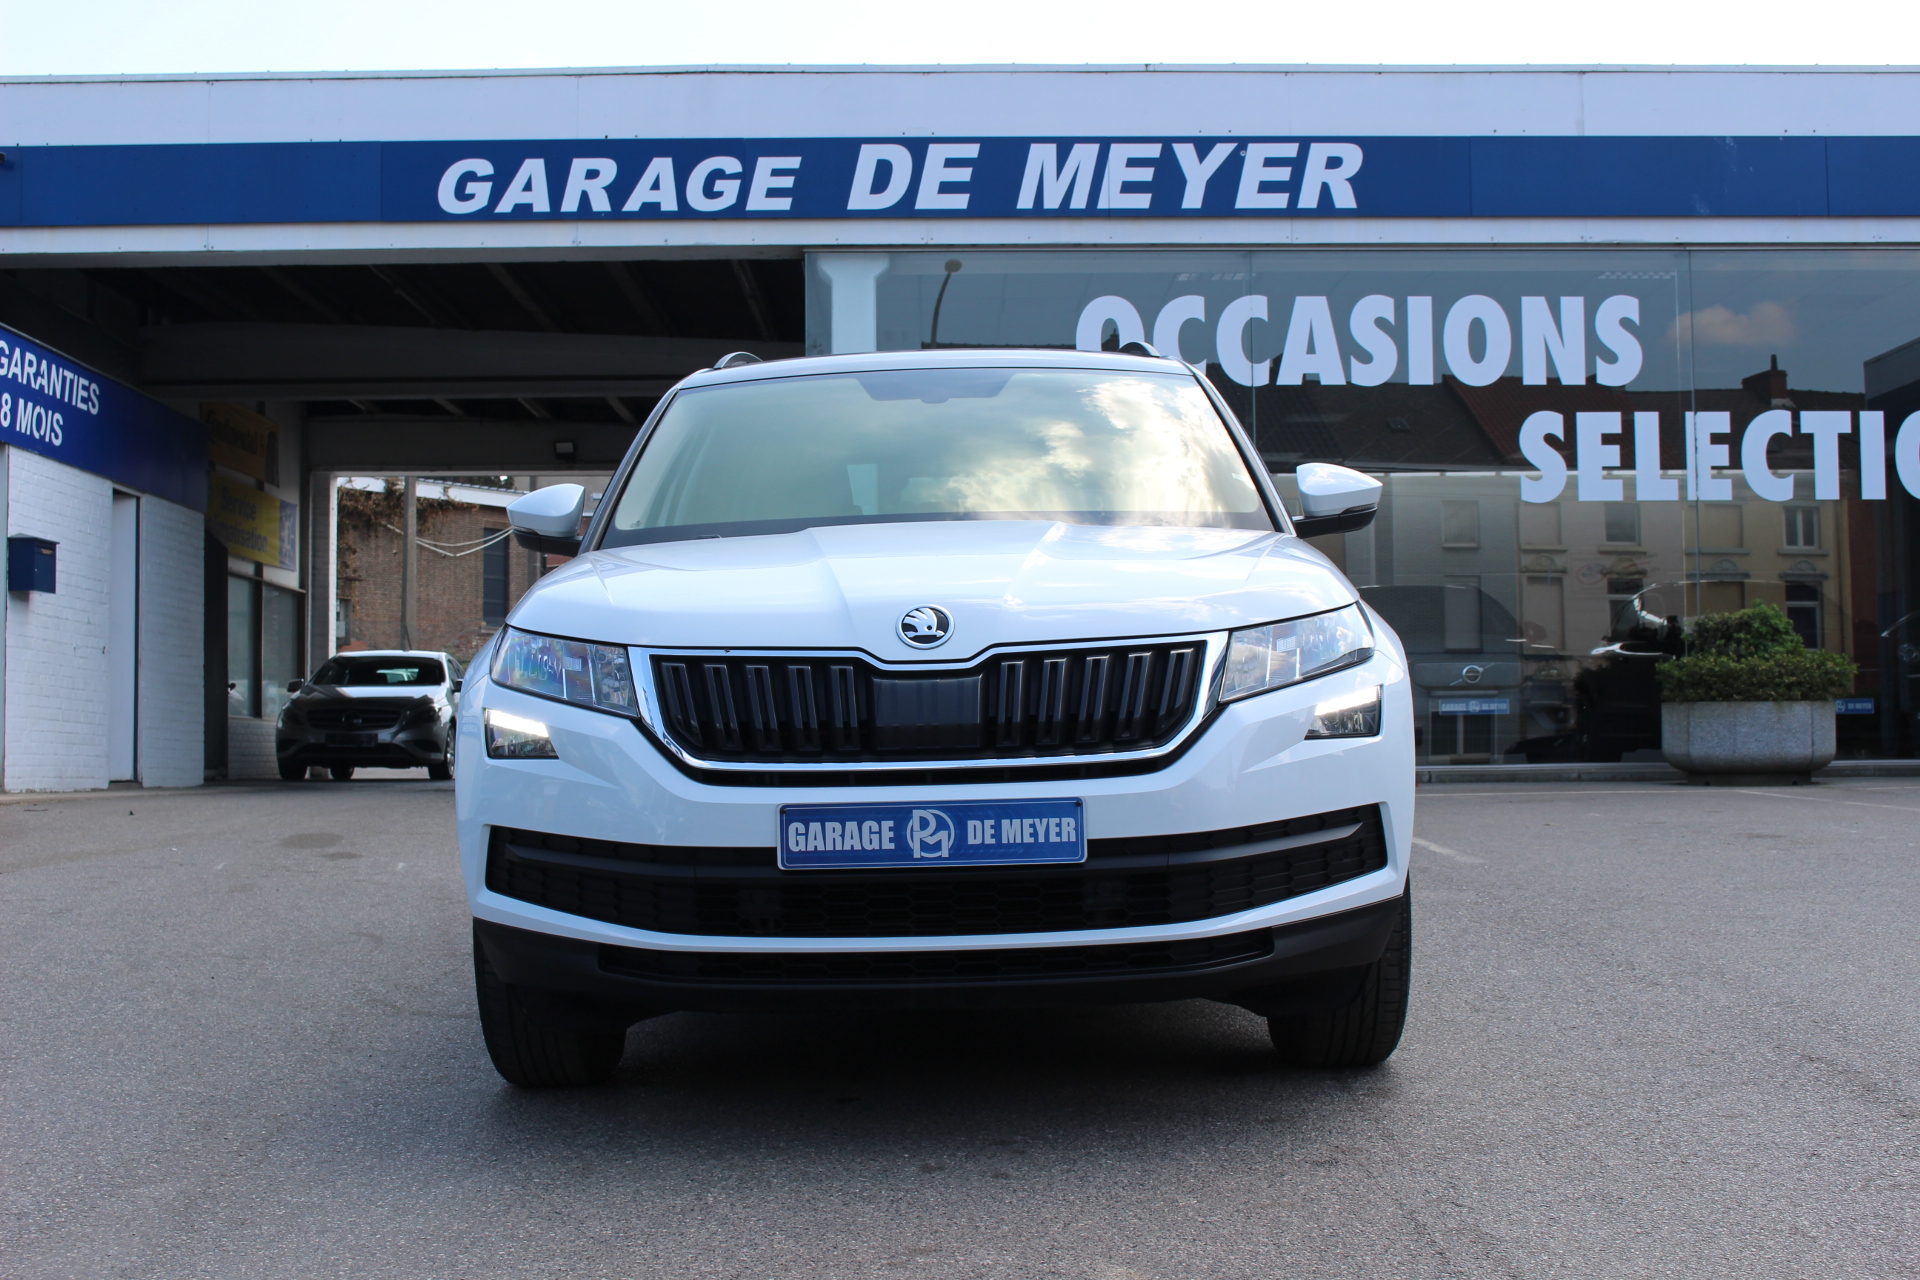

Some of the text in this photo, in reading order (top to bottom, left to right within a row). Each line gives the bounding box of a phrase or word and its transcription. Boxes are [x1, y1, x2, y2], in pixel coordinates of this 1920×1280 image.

[437, 142, 1364, 214] GARAGE DE MEYER
[1075, 294, 1644, 387] OCCASIONS
[16, 397, 64, 447] MOIS
[788, 819, 895, 852] GARAGE
[967, 819, 996, 845] DE
[1000, 817, 1077, 845] MEYER
